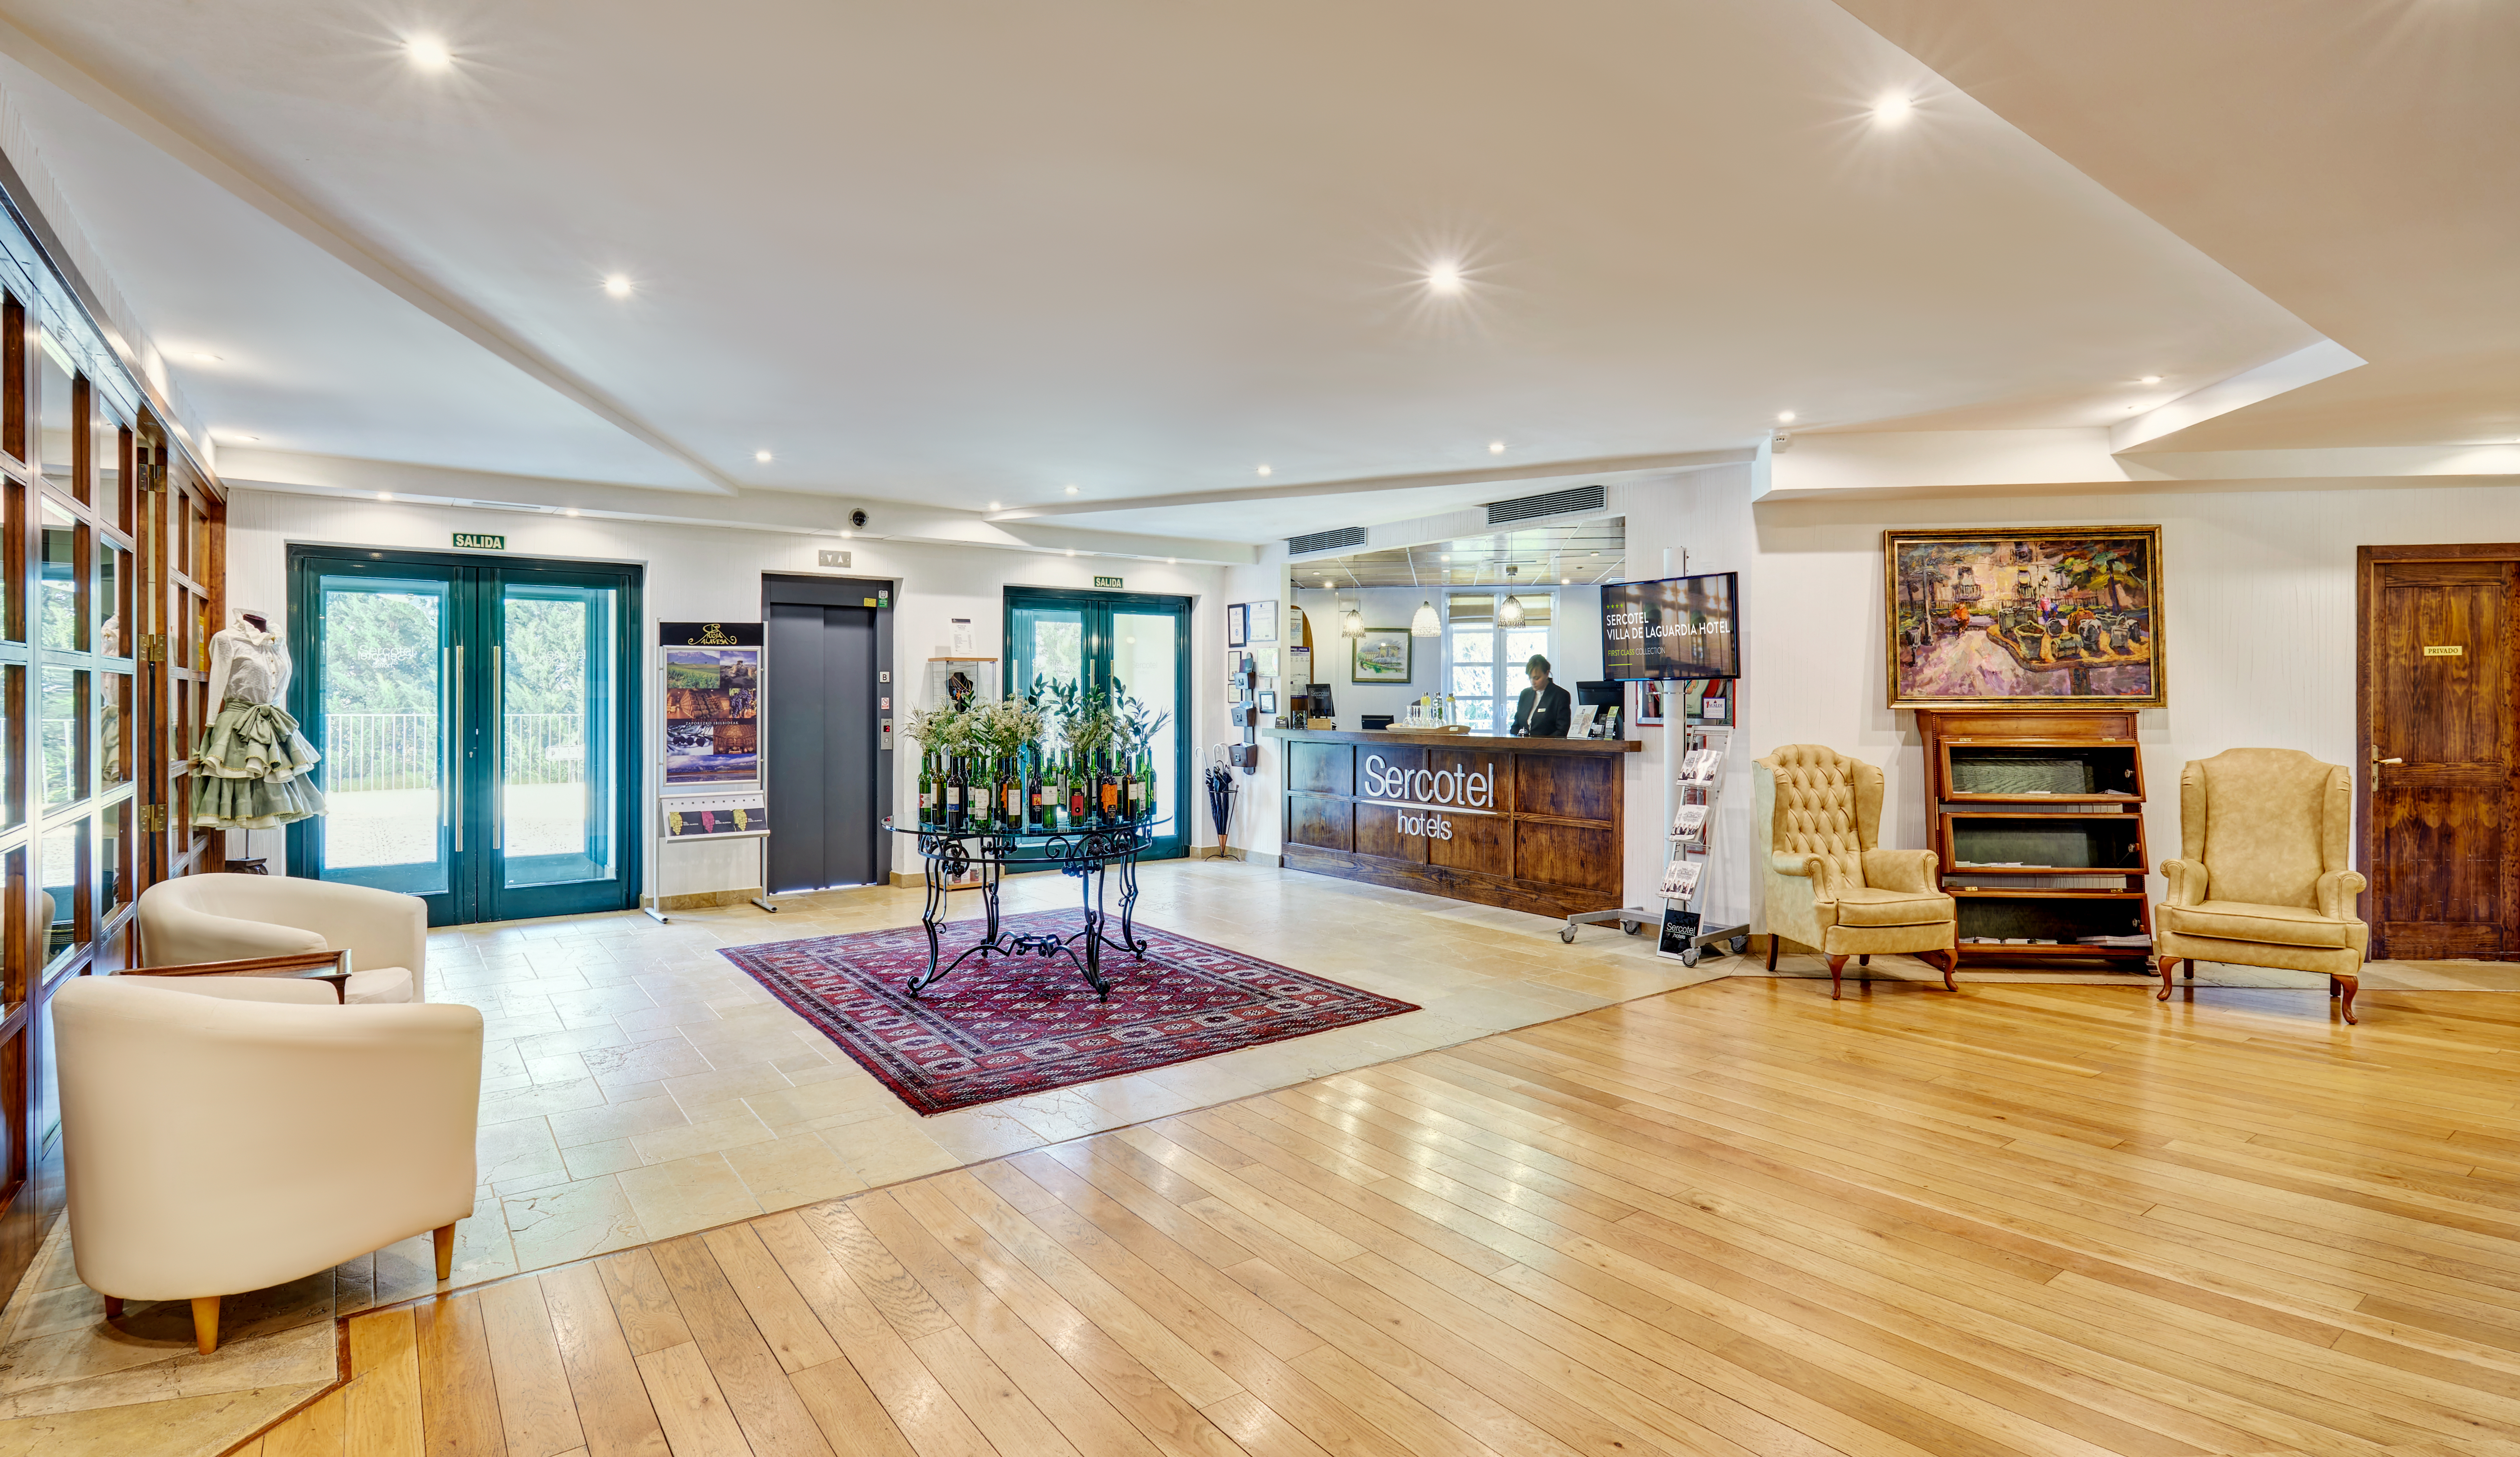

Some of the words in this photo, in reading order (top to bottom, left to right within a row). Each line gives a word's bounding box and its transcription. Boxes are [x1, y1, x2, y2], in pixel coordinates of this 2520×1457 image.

[456, 535, 502, 549] SALIDA
[1096, 578, 1121, 587] SALIDA
[1606, 612, 1648, 626] SERCOTEL
[1606, 628, 1630, 640] VILLA
[1632, 627, 1643, 639] DE
[1646, 623, 1697, 638] LAGUARDIA
[1699, 621, 1730, 635] HOTEL
[359, 644, 414, 656] Sercotel
[1635, 647, 1665, 655] COLLECTION
[1365, 755, 1493, 807] Sercotel
[1398, 809, 1452, 840] hotels
[1667, 922, 1696, 934] Sercotel
